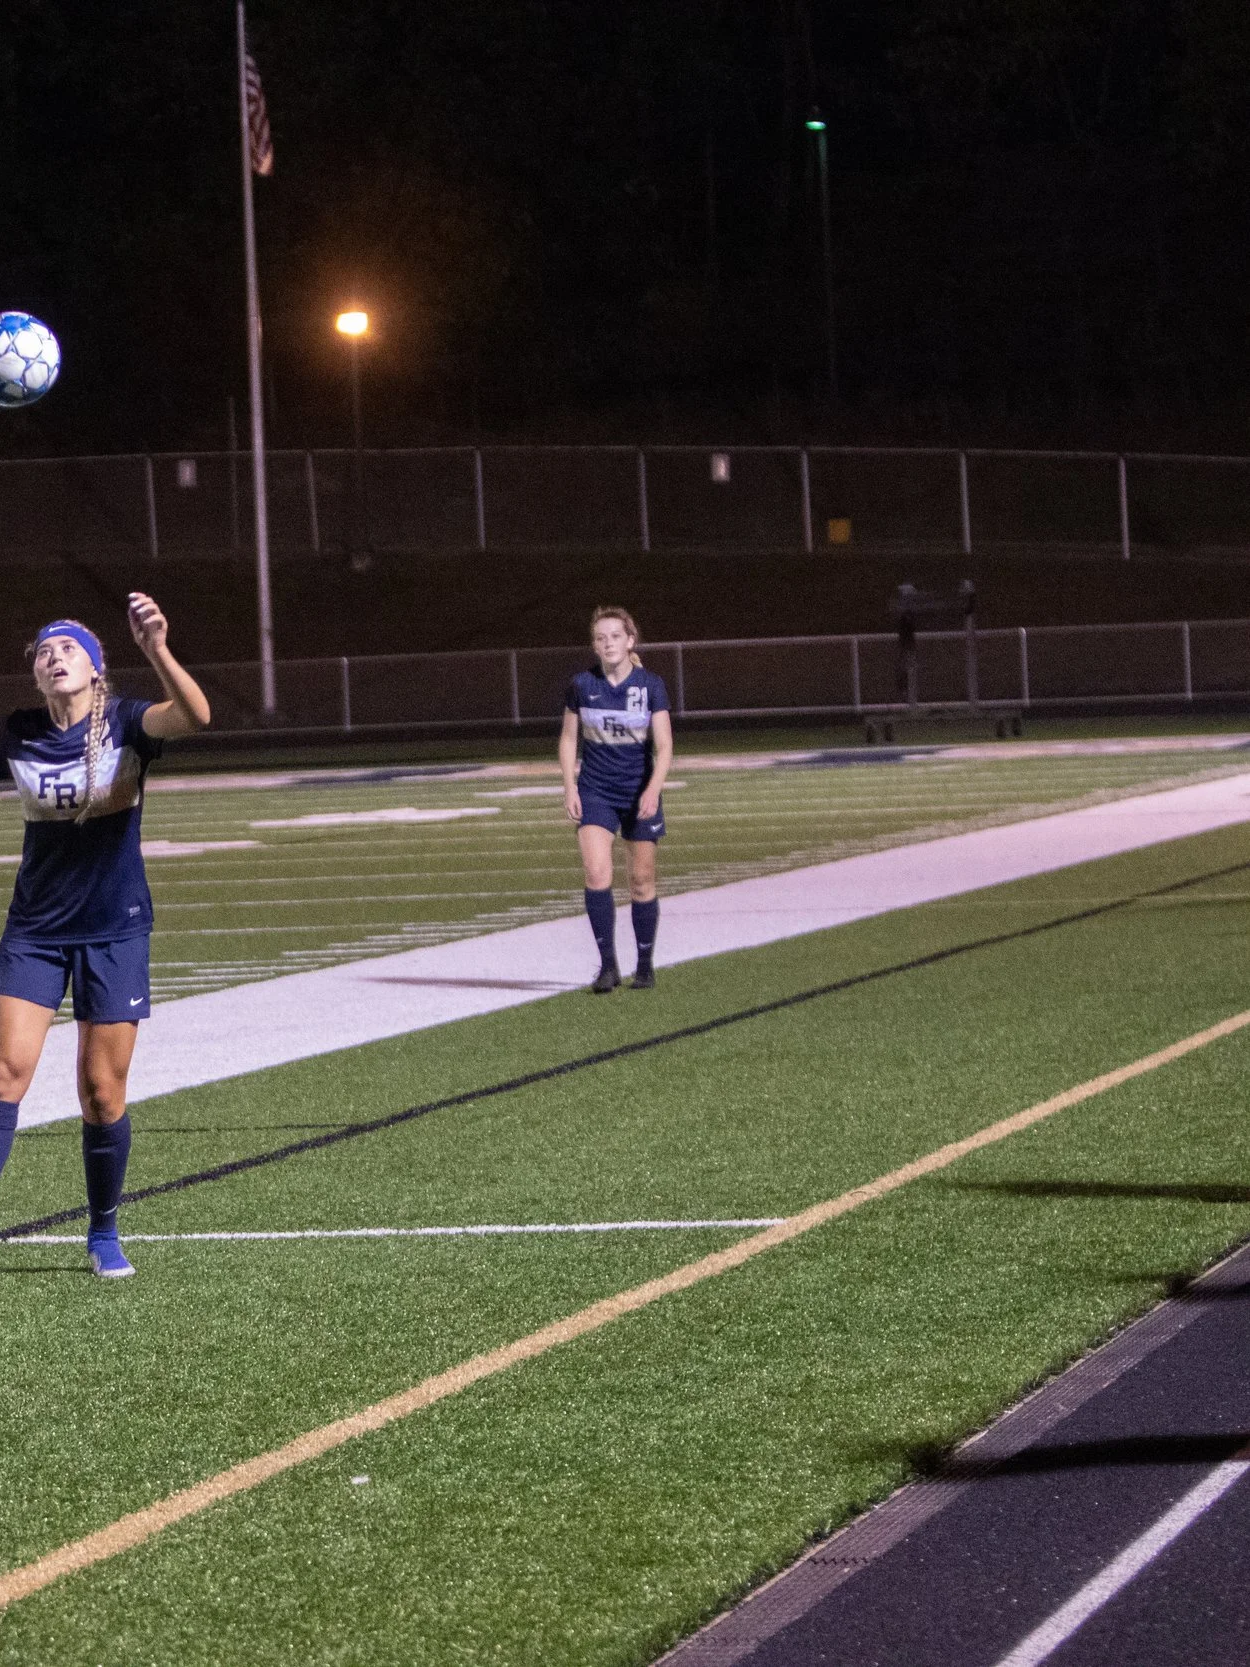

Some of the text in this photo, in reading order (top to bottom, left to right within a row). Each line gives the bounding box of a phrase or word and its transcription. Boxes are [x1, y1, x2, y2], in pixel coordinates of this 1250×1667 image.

[627, 686, 648, 715] 21
[603, 716, 626, 737] FR
[38, 772, 79, 810] FR
